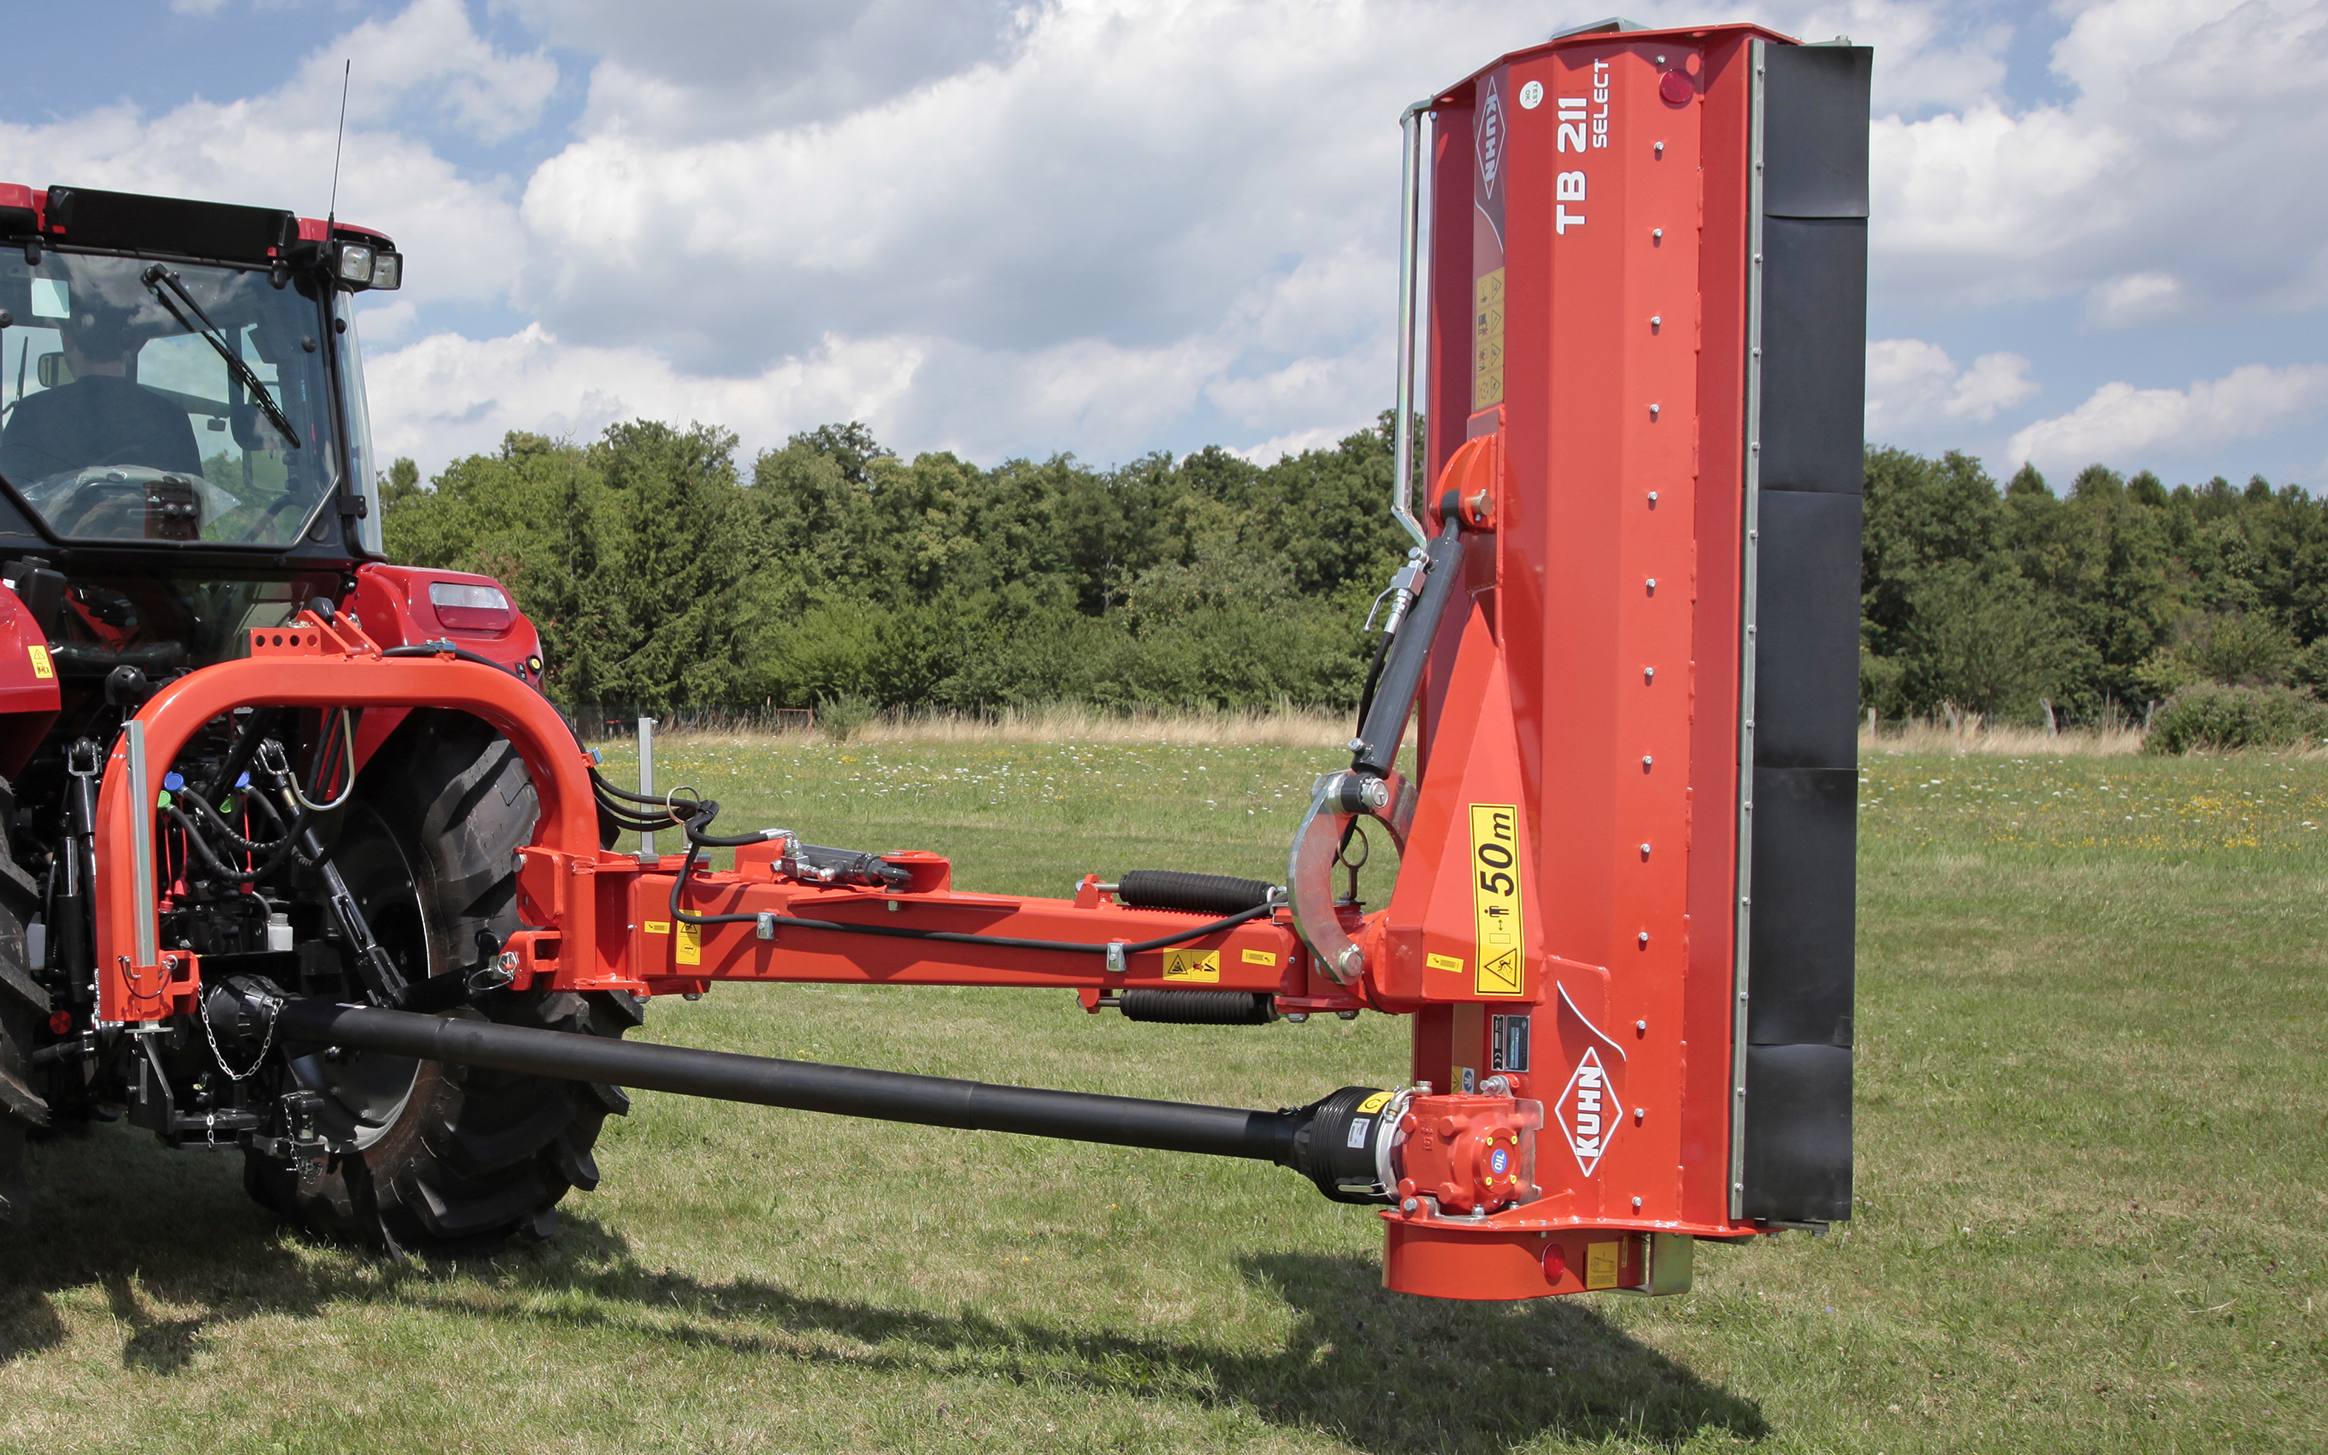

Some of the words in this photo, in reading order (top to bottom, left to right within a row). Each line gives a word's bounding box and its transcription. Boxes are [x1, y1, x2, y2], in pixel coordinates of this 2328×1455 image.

[1525, 90, 1530, 101] OK
[1557, 98, 1587, 153] 211
[1593, 58, 1609, 148] SELECT
[1486, 94, 1497, 182] KUHN
[1556, 171, 1586, 235] TB
[1576, 1066, 1602, 1157] KUHN
[1494, 1153, 1505, 1171] OIL
